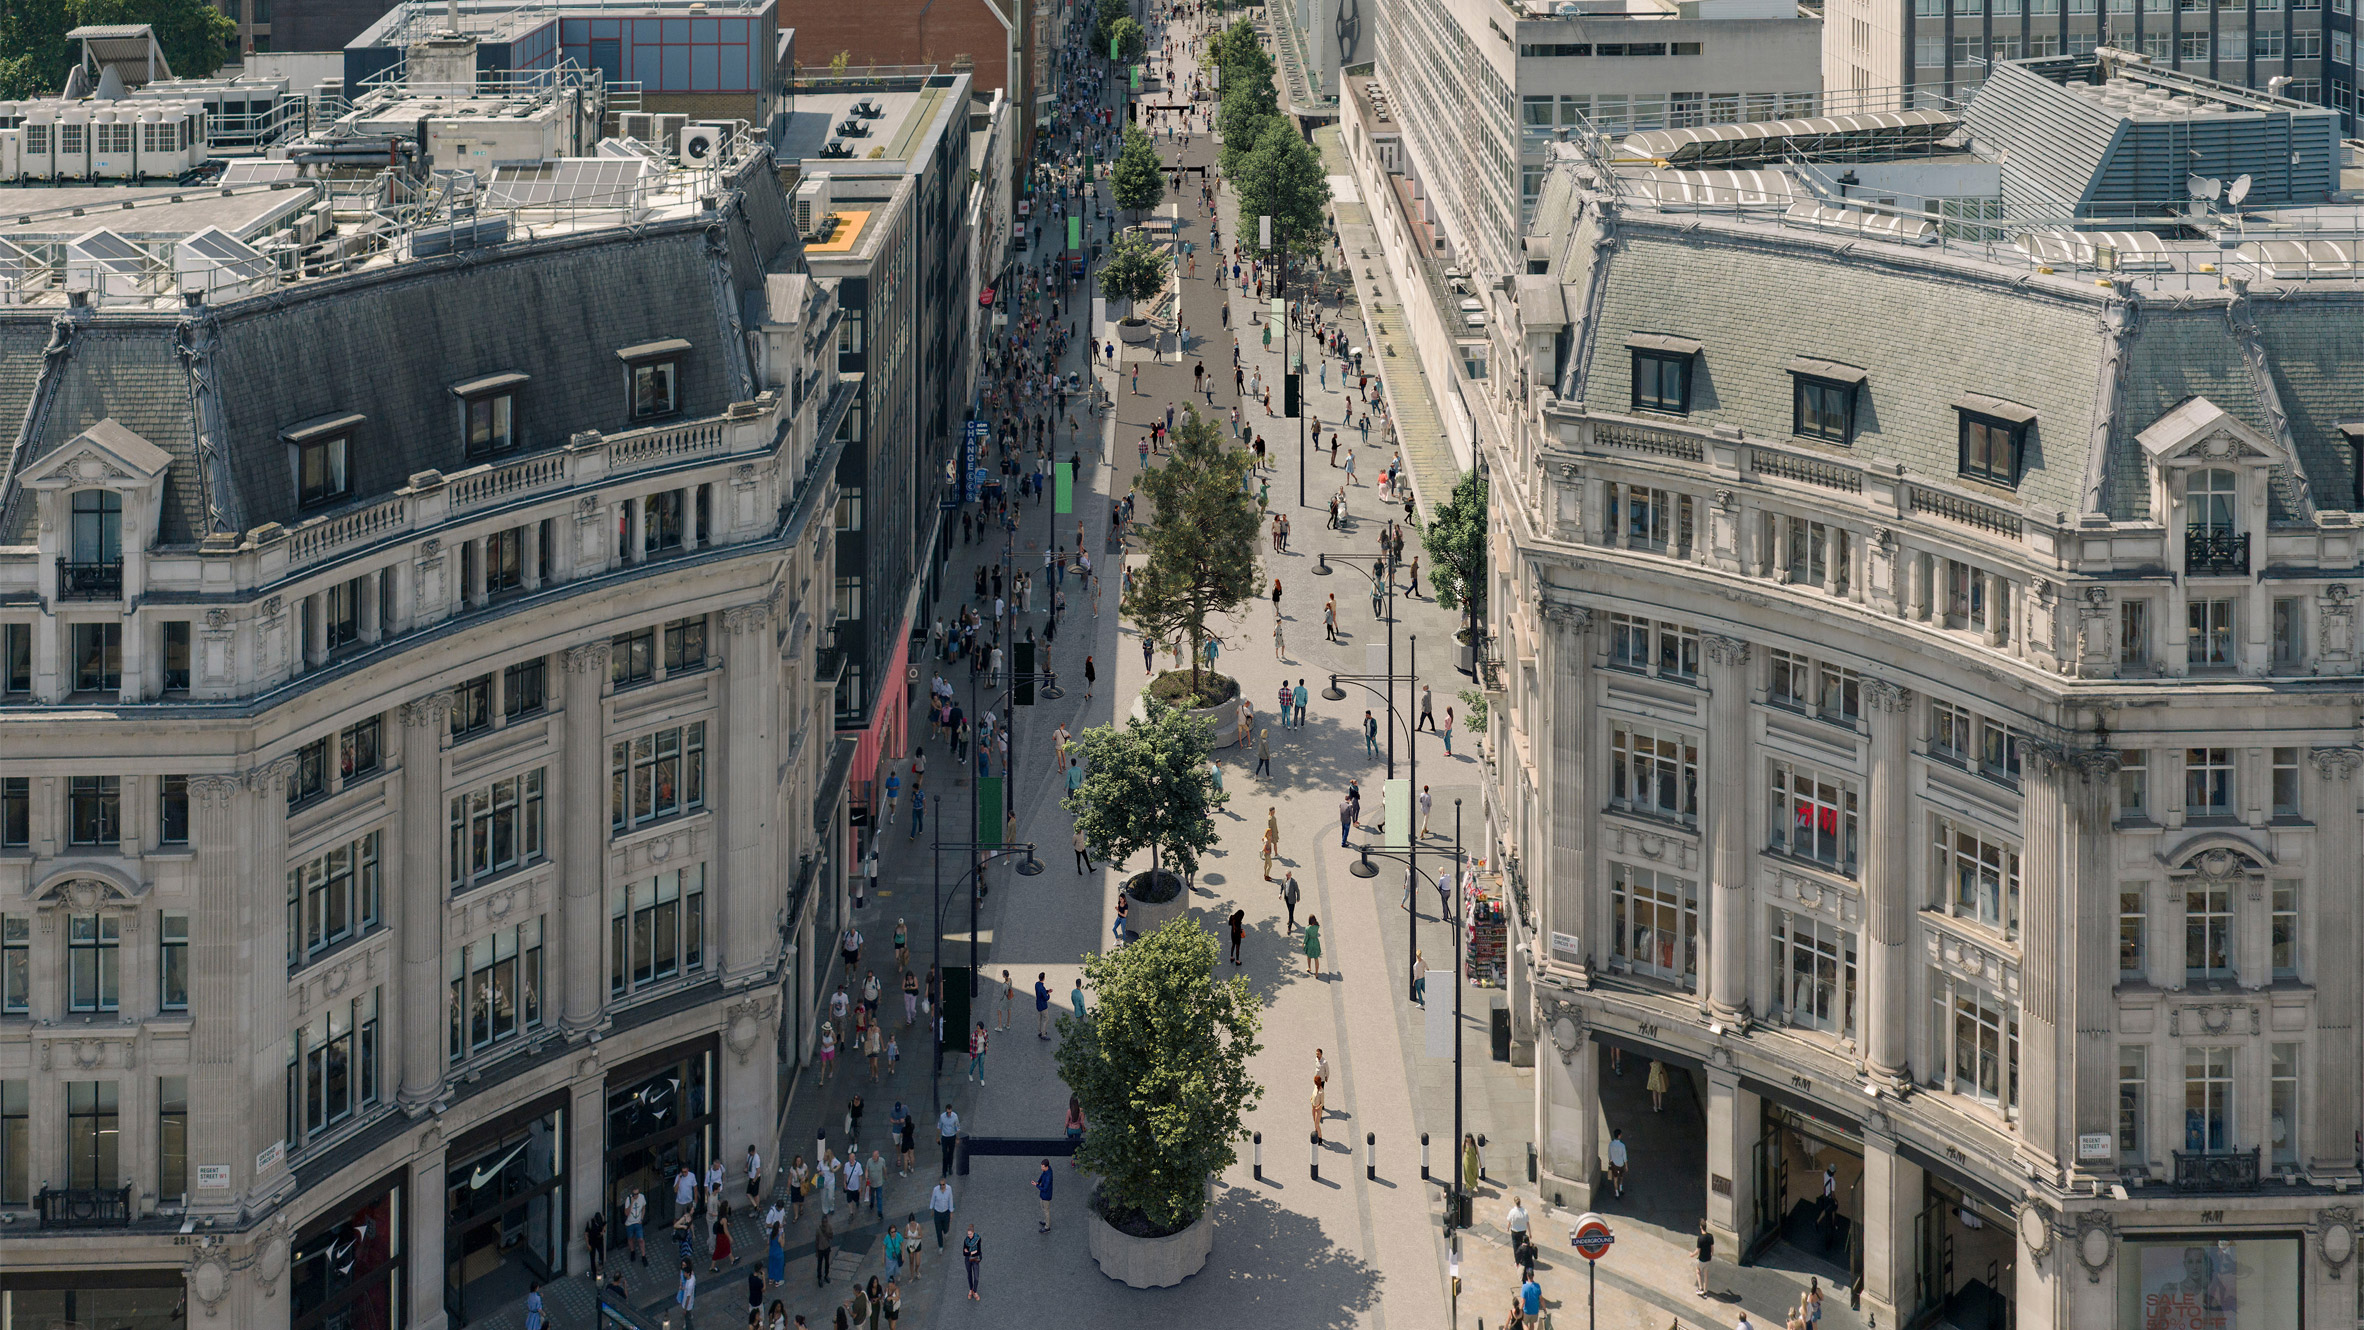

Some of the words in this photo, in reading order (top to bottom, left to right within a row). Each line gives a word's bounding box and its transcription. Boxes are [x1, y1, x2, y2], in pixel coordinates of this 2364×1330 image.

[967, 421, 975, 470] CHANGE
[1554, 934, 1570, 942] OXFORD
[1638, 1021, 1658, 1038] H&M
[1791, 1074, 1811, 1092] H&M
[259, 1147, 276, 1161] OXFORD
[259, 1153, 275, 1167] CIRCUS
[1946, 1145, 1966, 1166] H&M
[2201, 1210, 2224, 1223] H&M
[173, 1236, 191, 1245] 251
[2146, 1293, 2195, 1306] SALE
[2147, 1305, 2172, 1318] UP
[2175, 1305, 2202, 1317] TO
[2146, 1318, 2186, 1330] 50%
[2190, 1317, 2227, 1330] OFF
